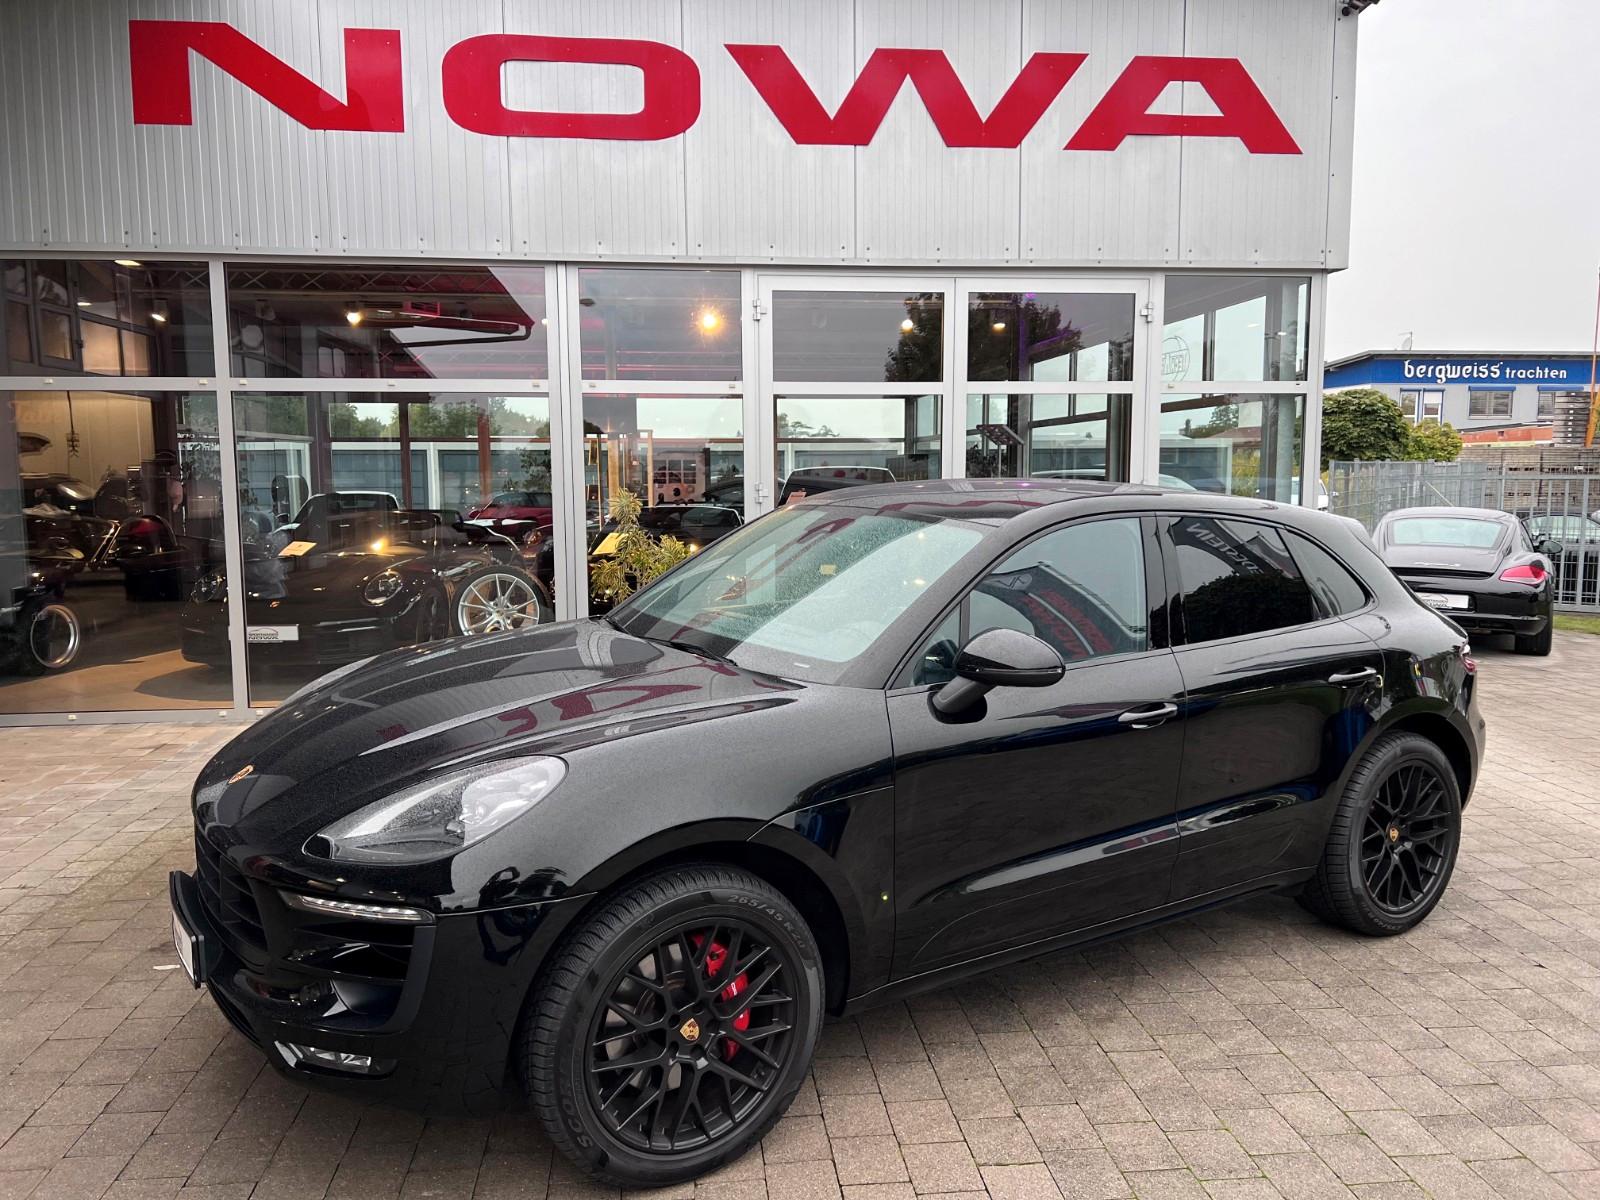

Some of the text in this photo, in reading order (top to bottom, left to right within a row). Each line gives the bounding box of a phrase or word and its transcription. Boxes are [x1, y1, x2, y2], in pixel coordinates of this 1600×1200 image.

[129, 20, 1302, 154] NOWA
[1404, 359, 1567, 384] bergweiss trachten
[728, 894, 784, 921] 265/45
